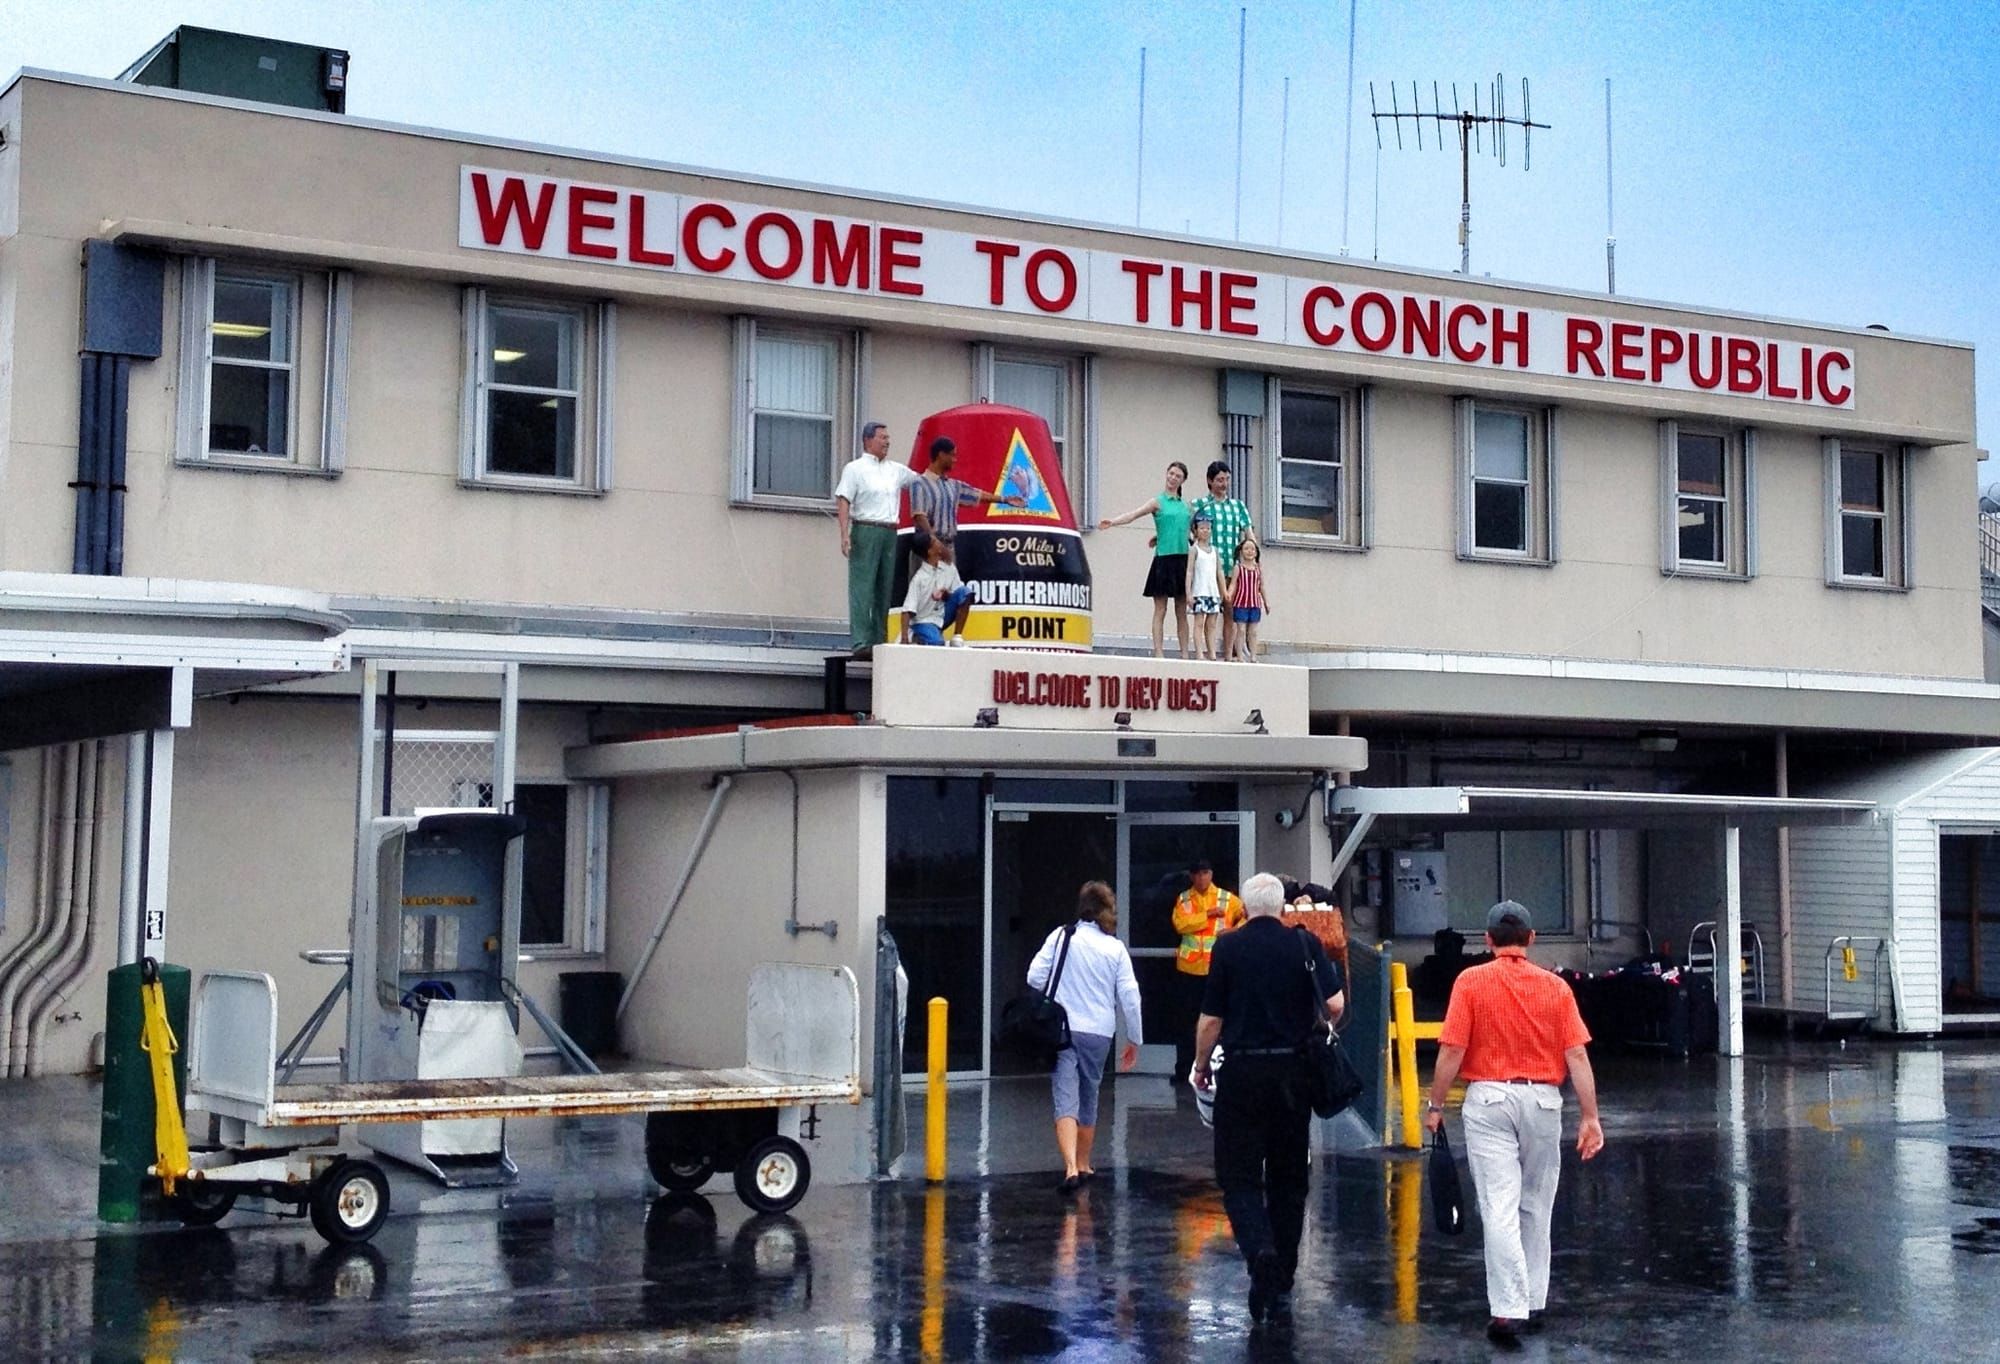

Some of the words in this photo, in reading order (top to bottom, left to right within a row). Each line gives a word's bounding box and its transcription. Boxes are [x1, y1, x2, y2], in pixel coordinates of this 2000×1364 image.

[471, 173, 923, 296] WELCOME
[976, 240, 1077, 313] TO
[1122, 260, 1258, 336] THE
[1303, 286, 1529, 367] CONCH
[1567, 318, 1850, 404] REPUBLIC
[996, 537, 1020, 553] 90
[1022, 536, 1054, 553] Miles
[1015, 552, 1056, 567] CUBA
[966, 579, 1090, 608] OUTHERNMOST
[1001, 616, 1066, 640] POINT
[993, 670, 1091, 709] WELCOME
[1098, 675, 1121, 709] TO
[1126, 677, 1162, 711] KEY
[1167, 678, 1219, 712] WEST
[415, 896, 444, 906] LOAD
